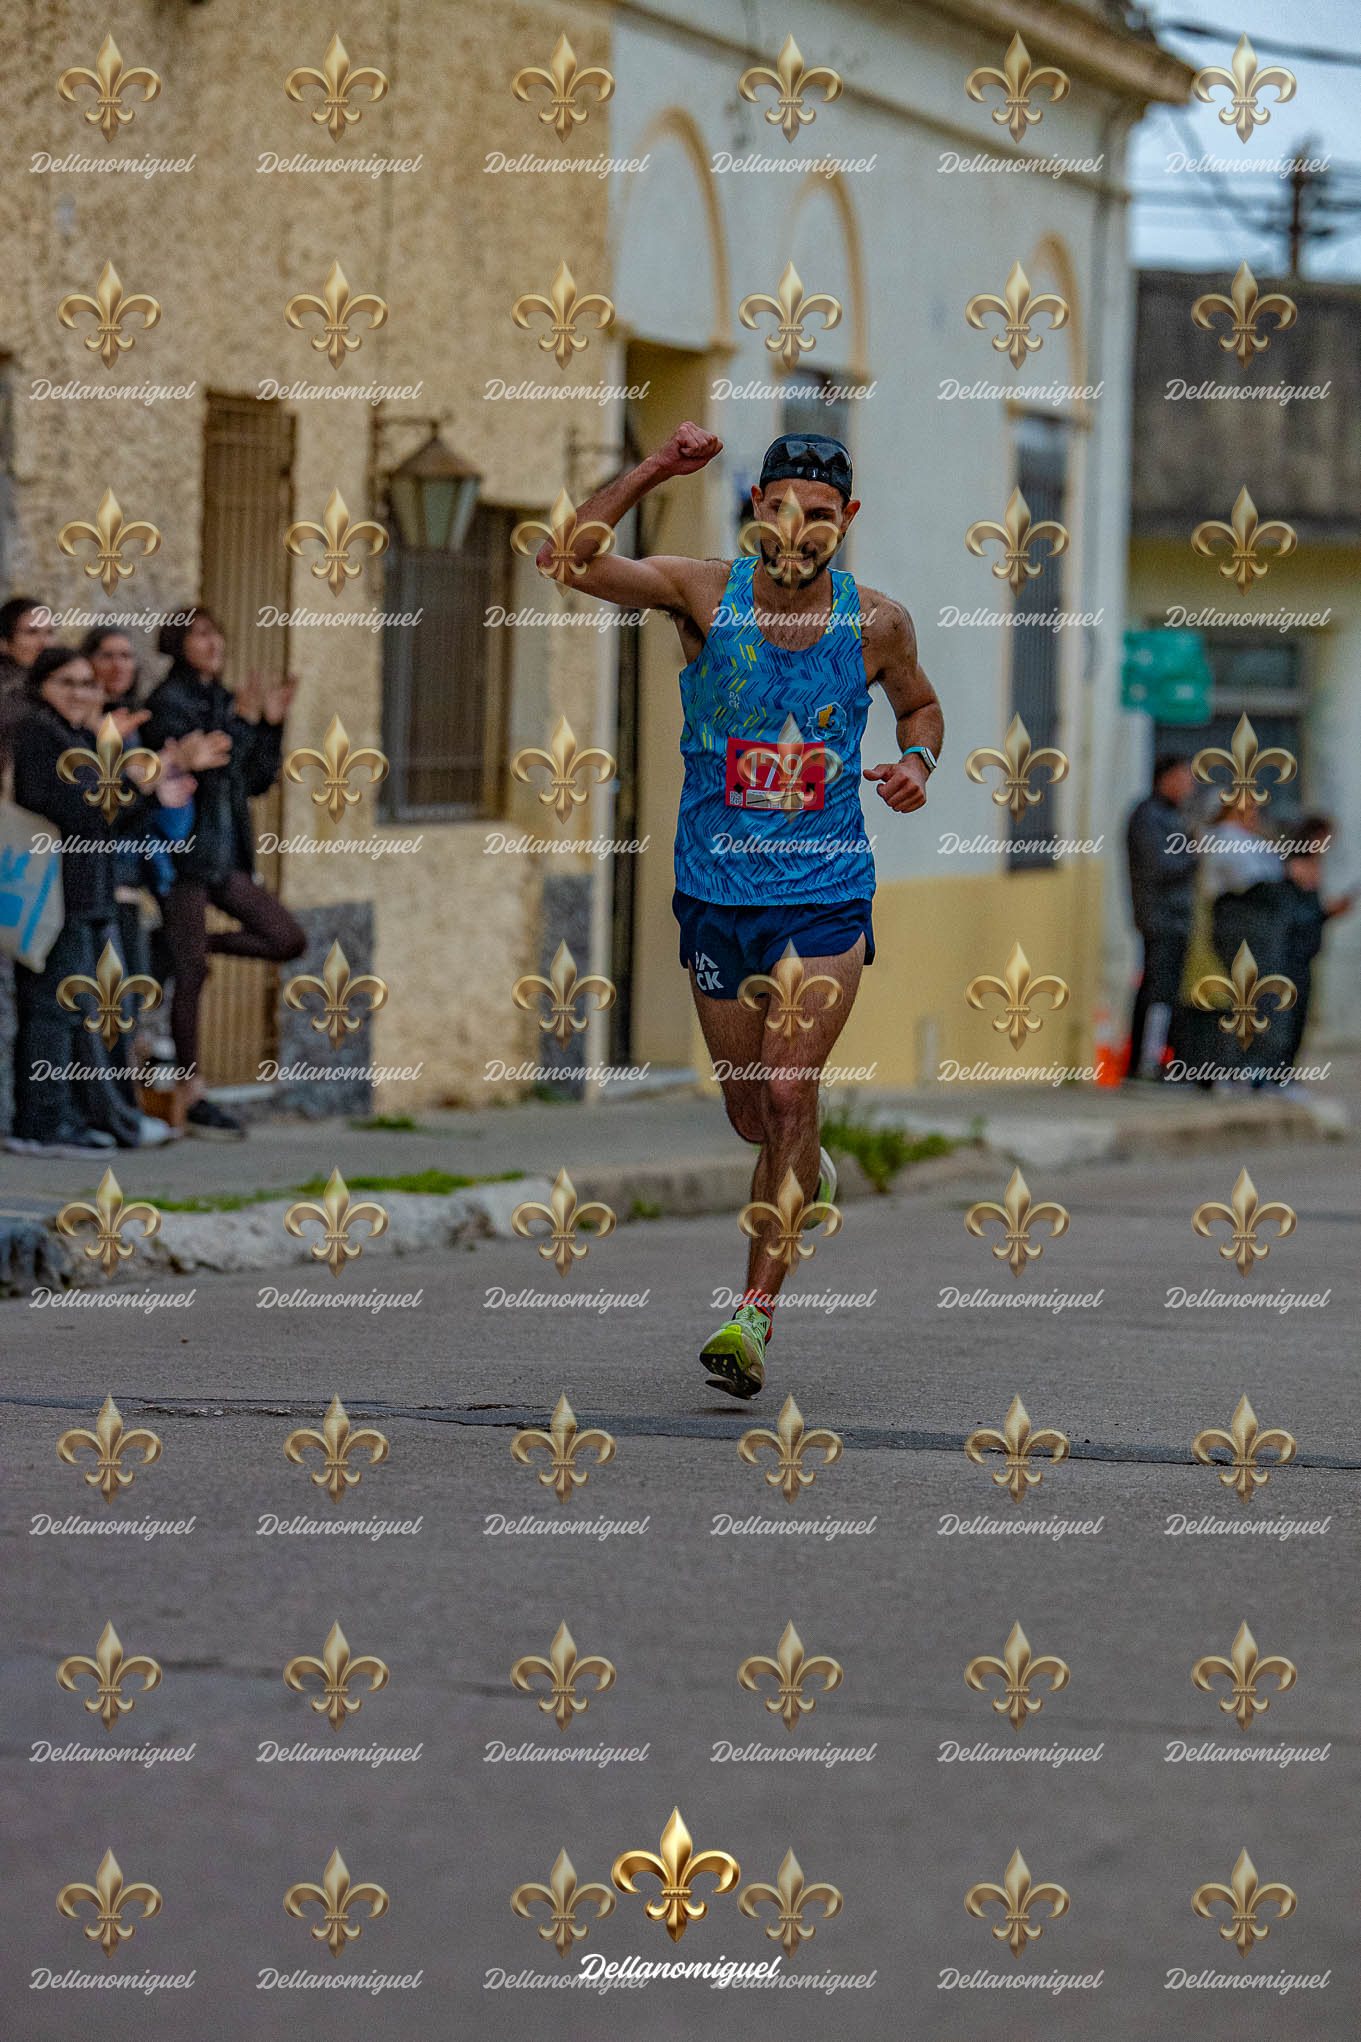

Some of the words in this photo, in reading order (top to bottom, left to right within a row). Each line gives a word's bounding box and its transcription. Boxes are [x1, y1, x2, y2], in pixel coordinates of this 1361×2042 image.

[746, 751, 803, 789] 179
[695, 951, 719, 971] A
[696, 971, 725, 991] CK
